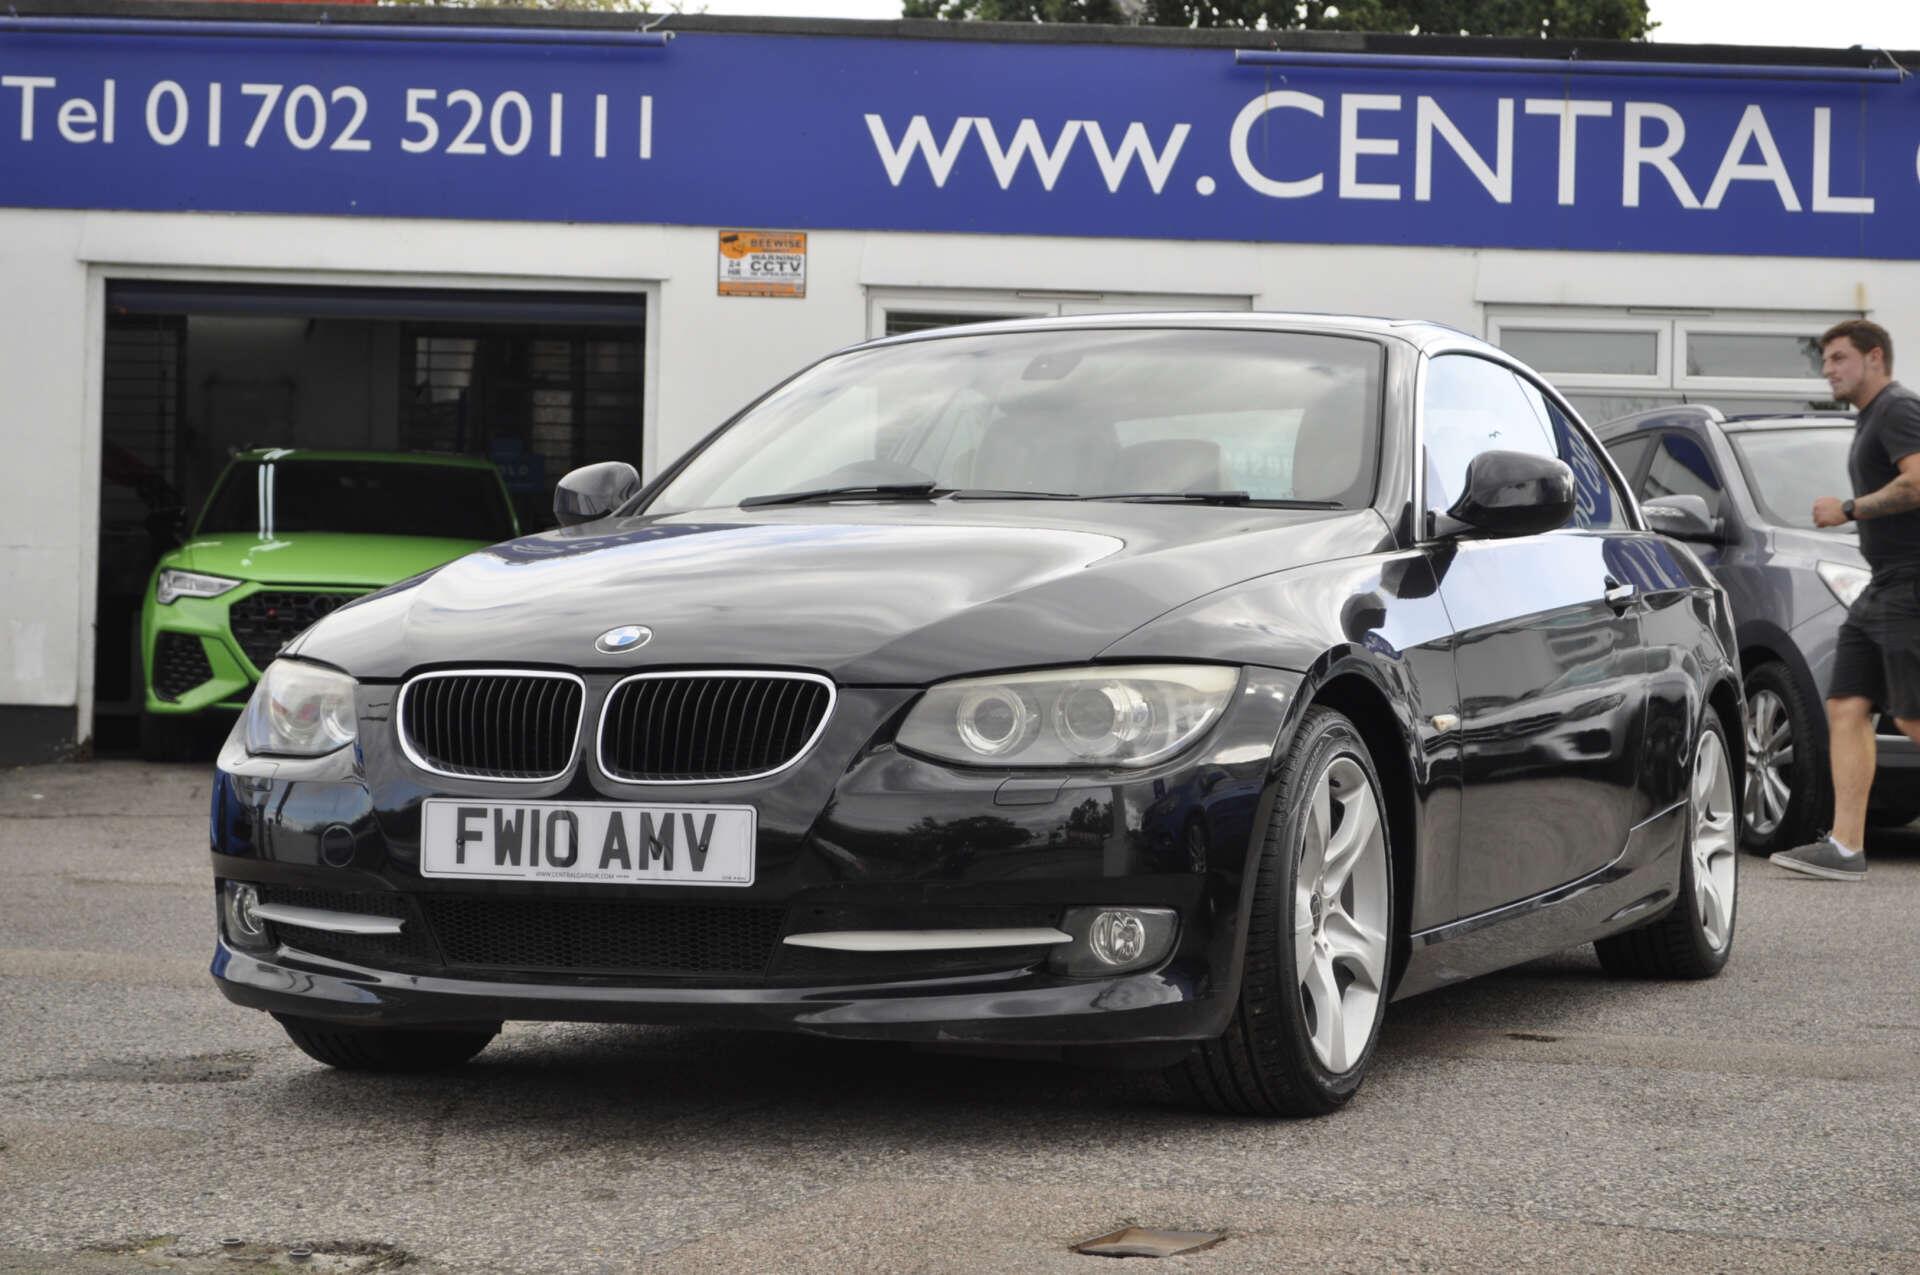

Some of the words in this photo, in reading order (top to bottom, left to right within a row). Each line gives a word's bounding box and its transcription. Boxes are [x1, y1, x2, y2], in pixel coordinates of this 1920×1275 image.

[2, 76, 115, 144] Tel
[146, 80, 371, 152] 01702
[401, 88, 652, 160] 520111
[750, 260, 801, 272] CCTV
[456, 807, 579, 868] FW10
[599, 811, 717, 872] AMV
